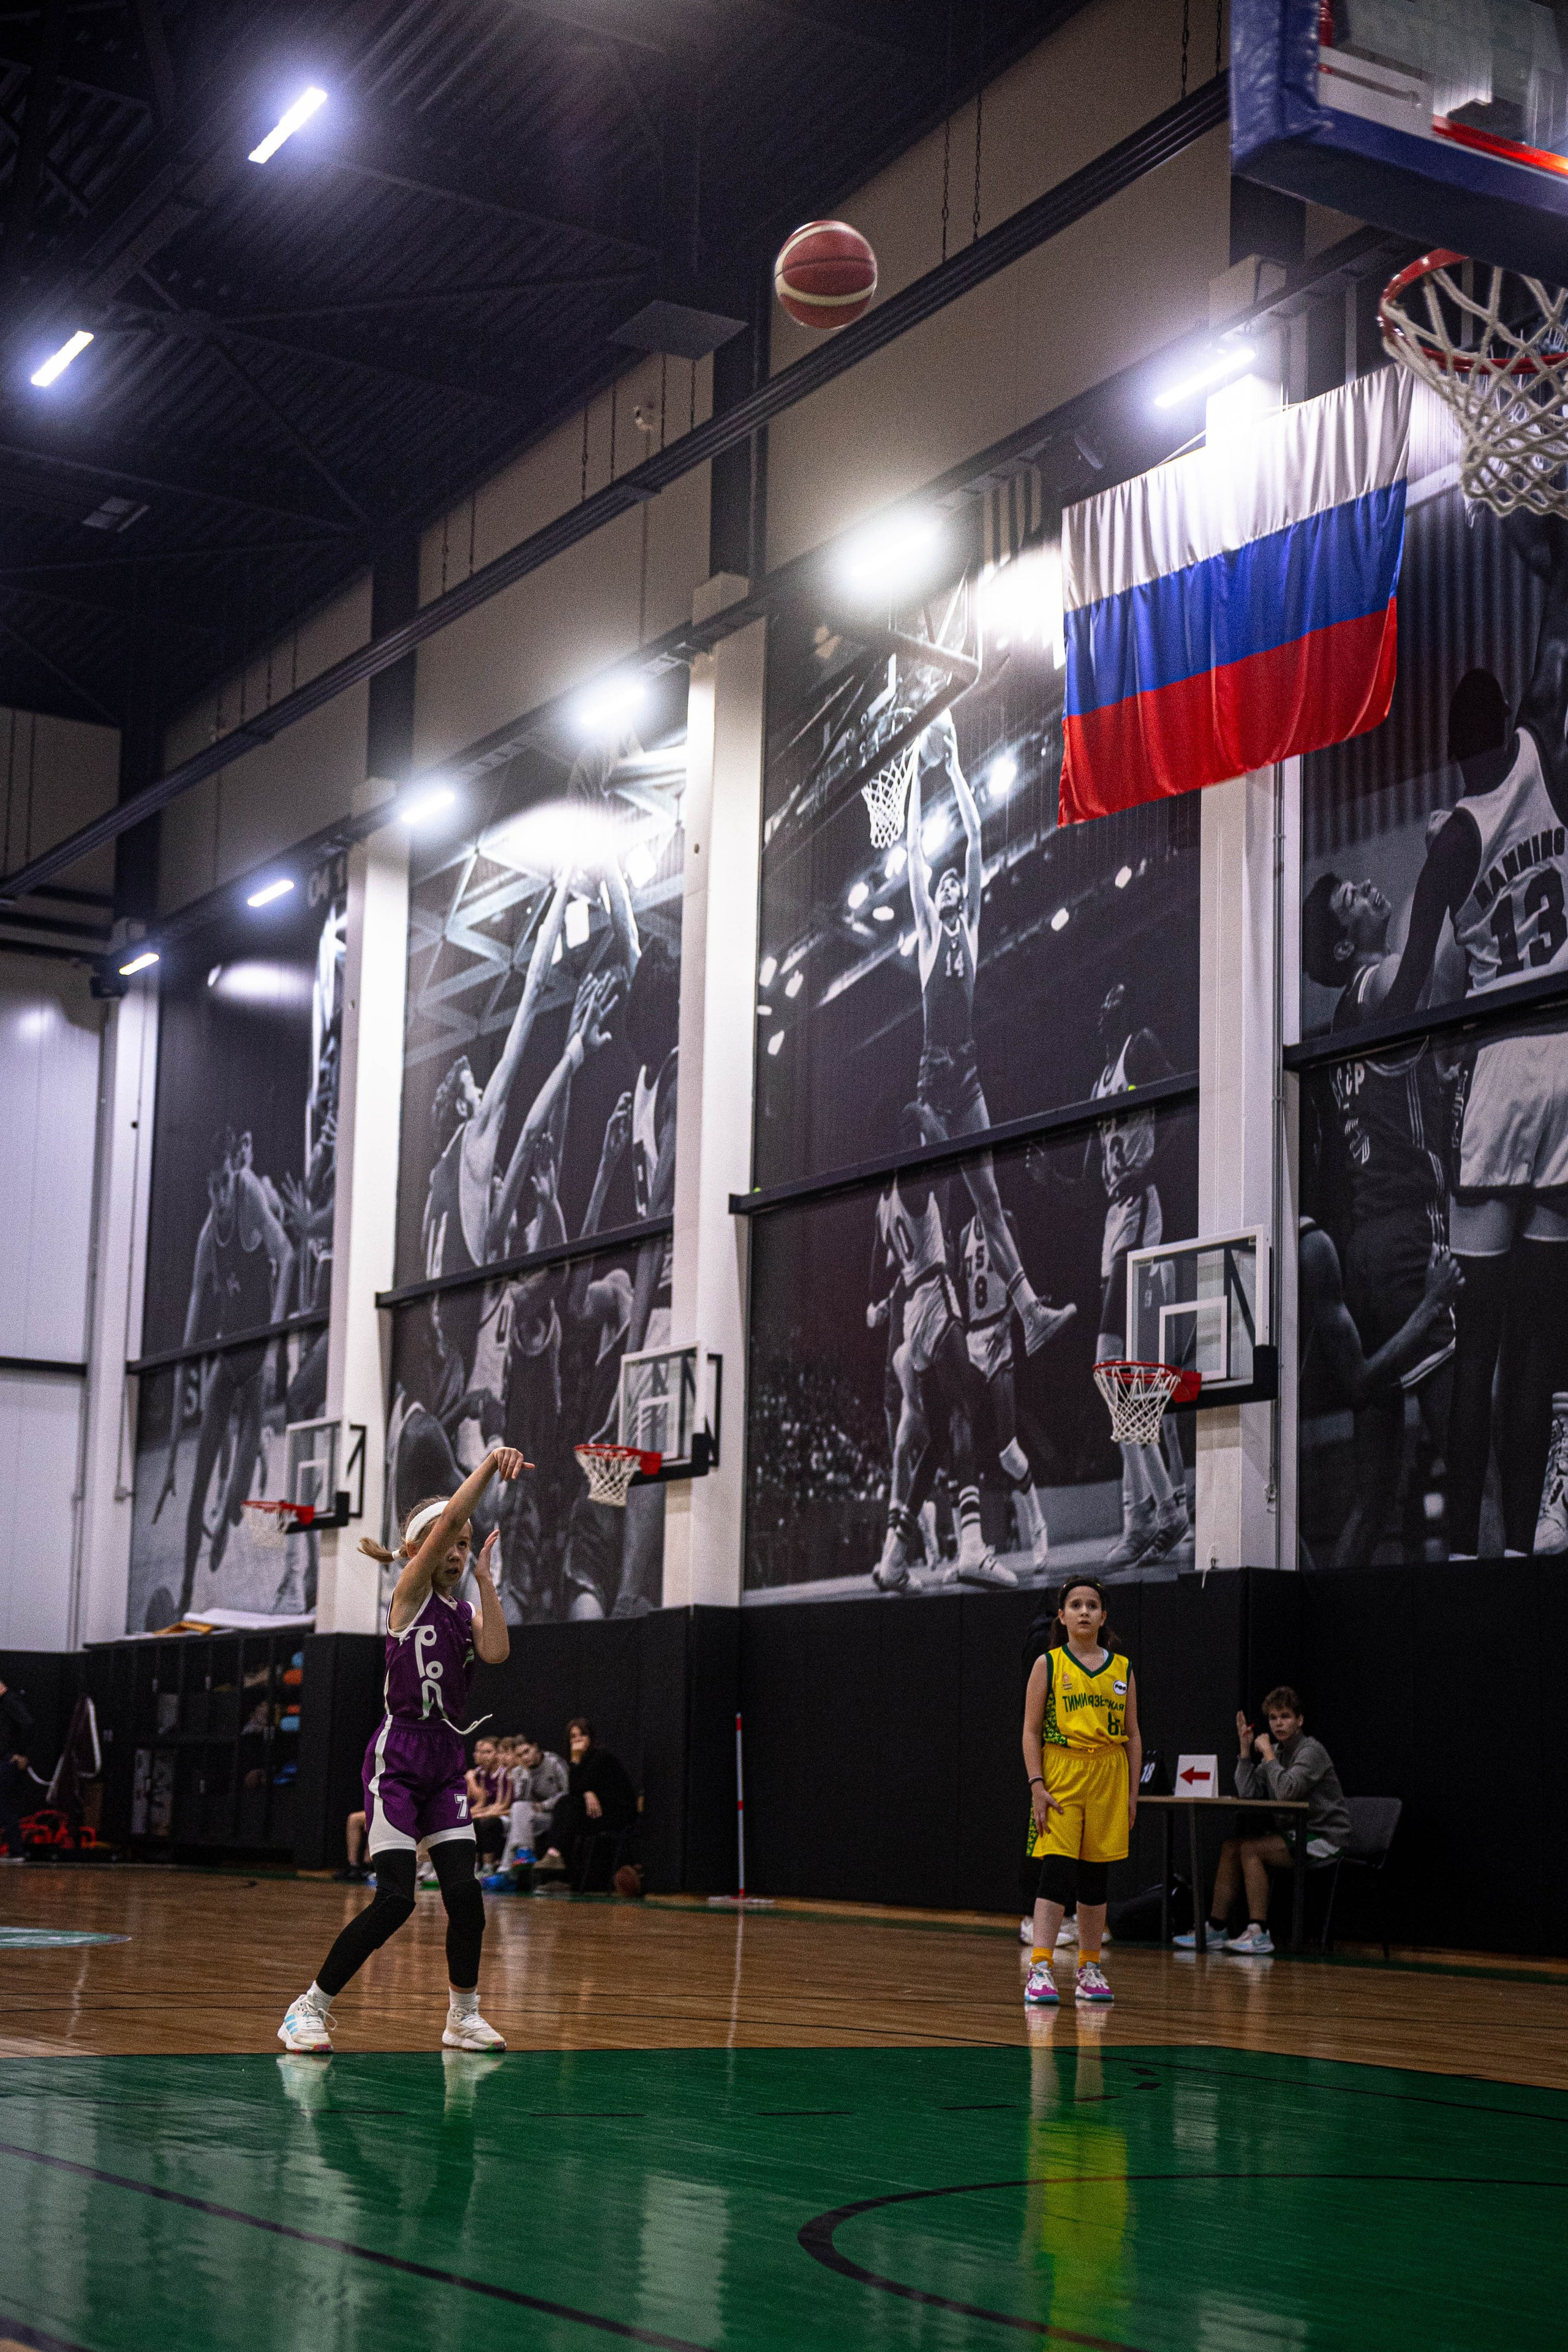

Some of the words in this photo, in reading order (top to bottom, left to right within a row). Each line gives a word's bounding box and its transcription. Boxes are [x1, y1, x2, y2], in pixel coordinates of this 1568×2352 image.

[1490, 867, 1568, 978] 13
[945, 950, 964, 978] 14
[975, 1275, 988, 1309] 8
[1140, 1762, 1156, 1783] 18
[454, 1793, 469, 1819] 7
